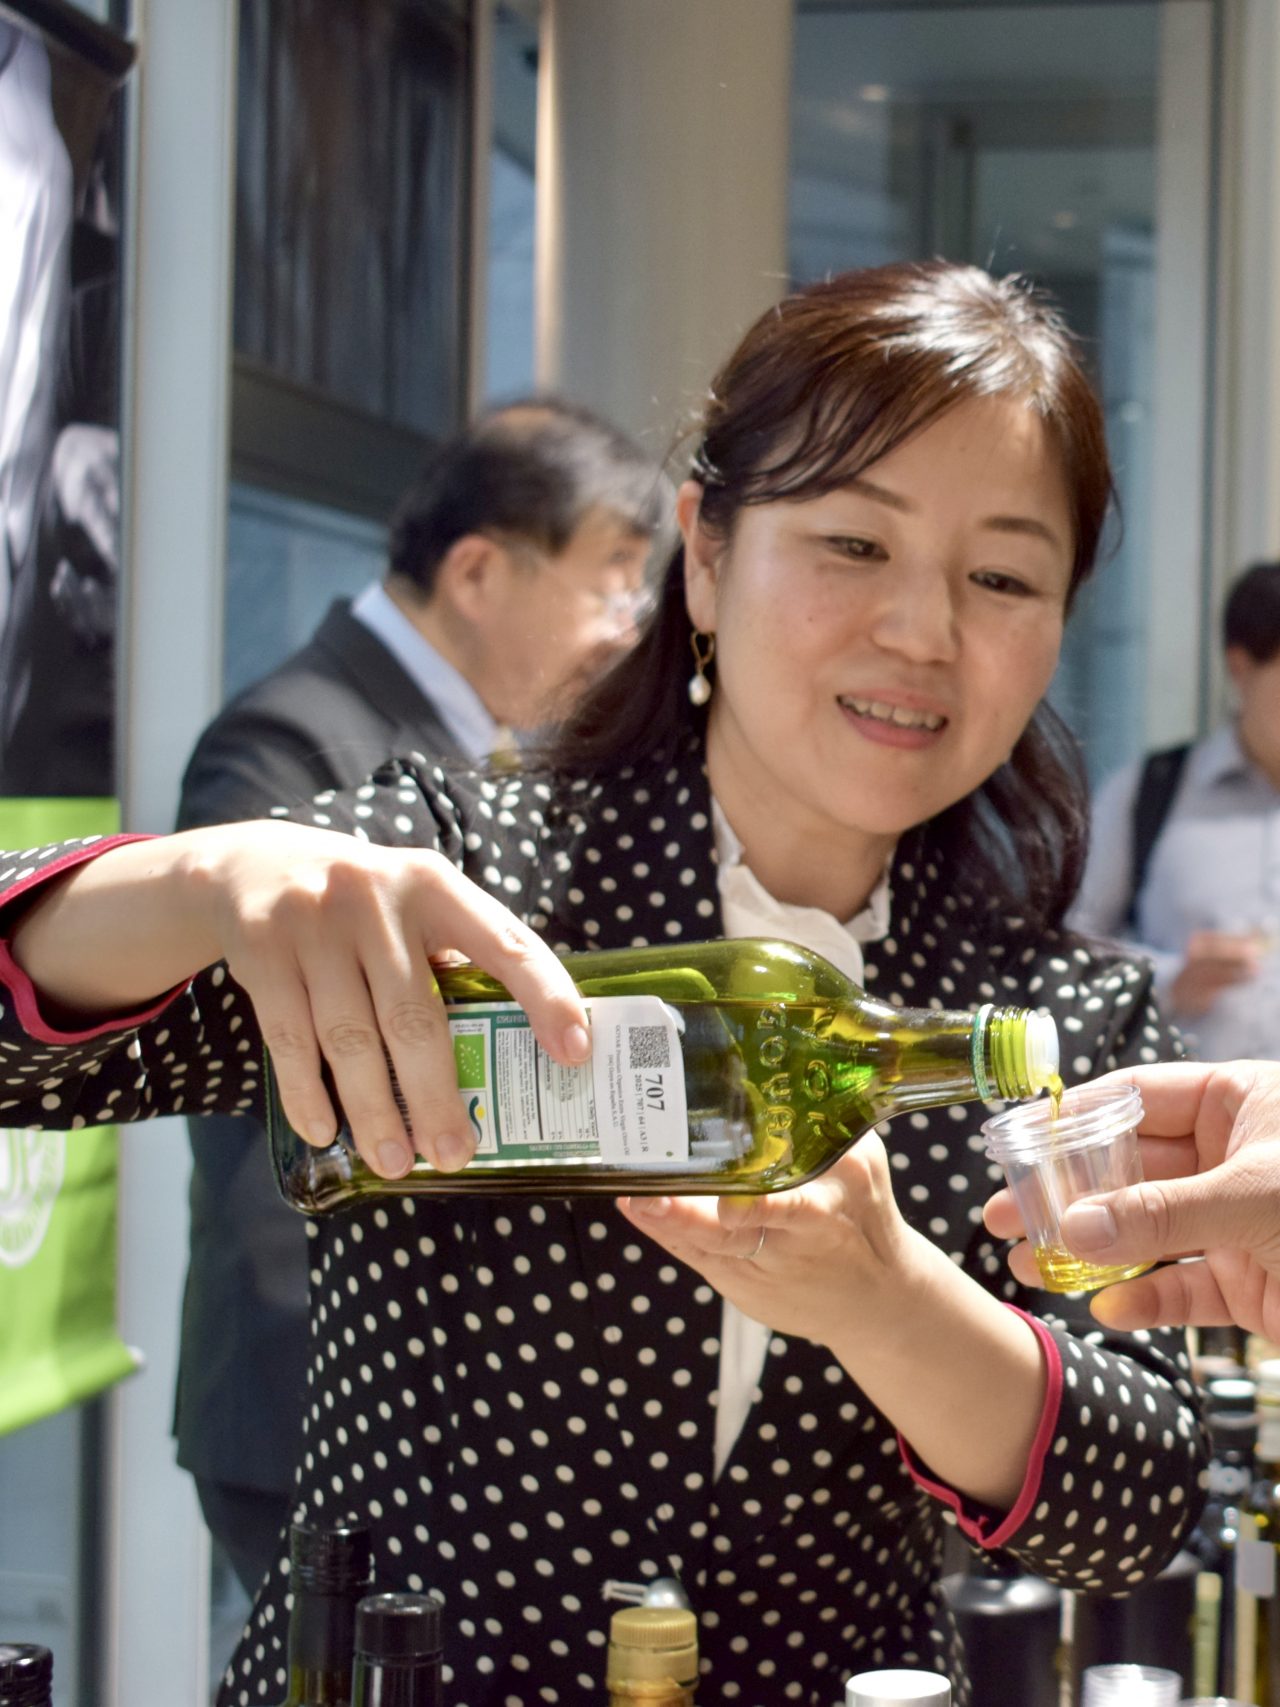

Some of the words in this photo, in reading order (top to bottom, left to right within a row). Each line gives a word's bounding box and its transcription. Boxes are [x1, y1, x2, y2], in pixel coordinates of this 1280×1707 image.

[634, 1073, 643, 1092] 2025
[644, 1073, 665, 1112] 707
[636, 1097, 644, 1110] 707
